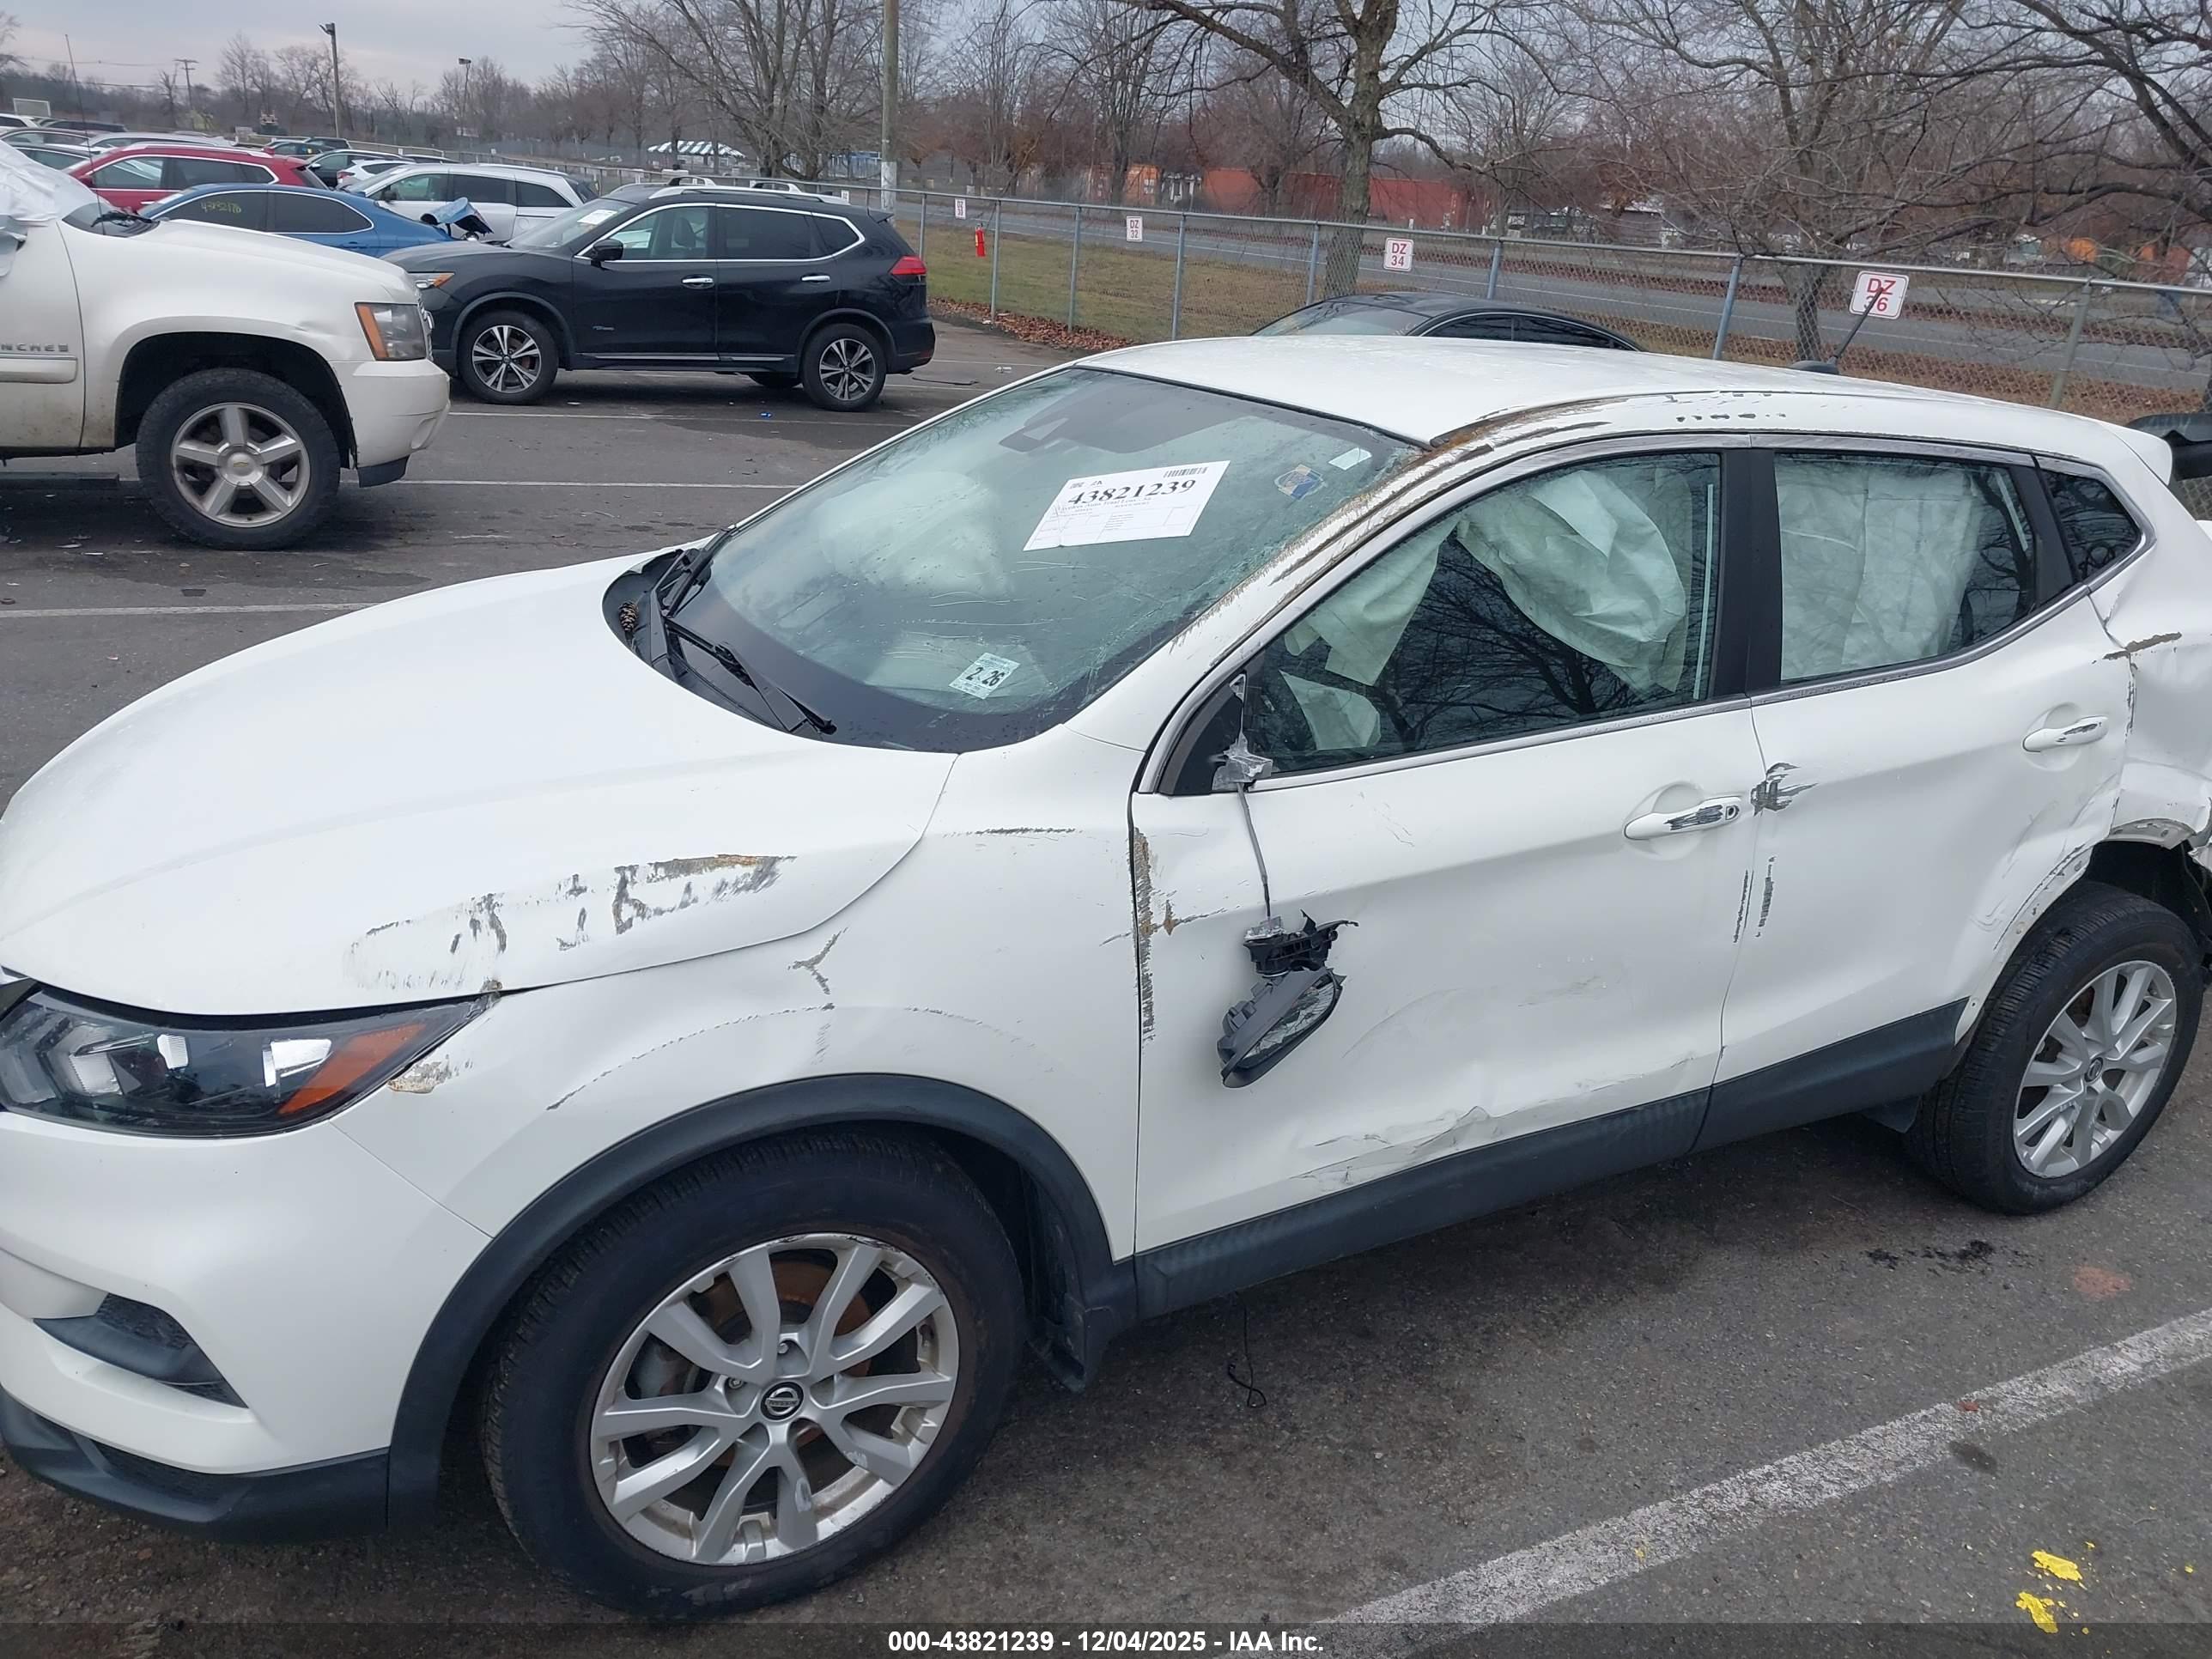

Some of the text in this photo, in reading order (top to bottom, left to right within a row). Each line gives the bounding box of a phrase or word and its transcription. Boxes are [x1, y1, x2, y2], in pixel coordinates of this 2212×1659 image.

[1130, 219, 1139, 228] DZ
[1130, 229, 1139, 239] 32
[1391, 242, 1407, 255] DZ
[1391, 255, 1405, 267] 34
[1867, 277, 1897, 295] DZ
[1863, 295, 1888, 312] 36
[1067, 479, 1196, 505] 43821239
